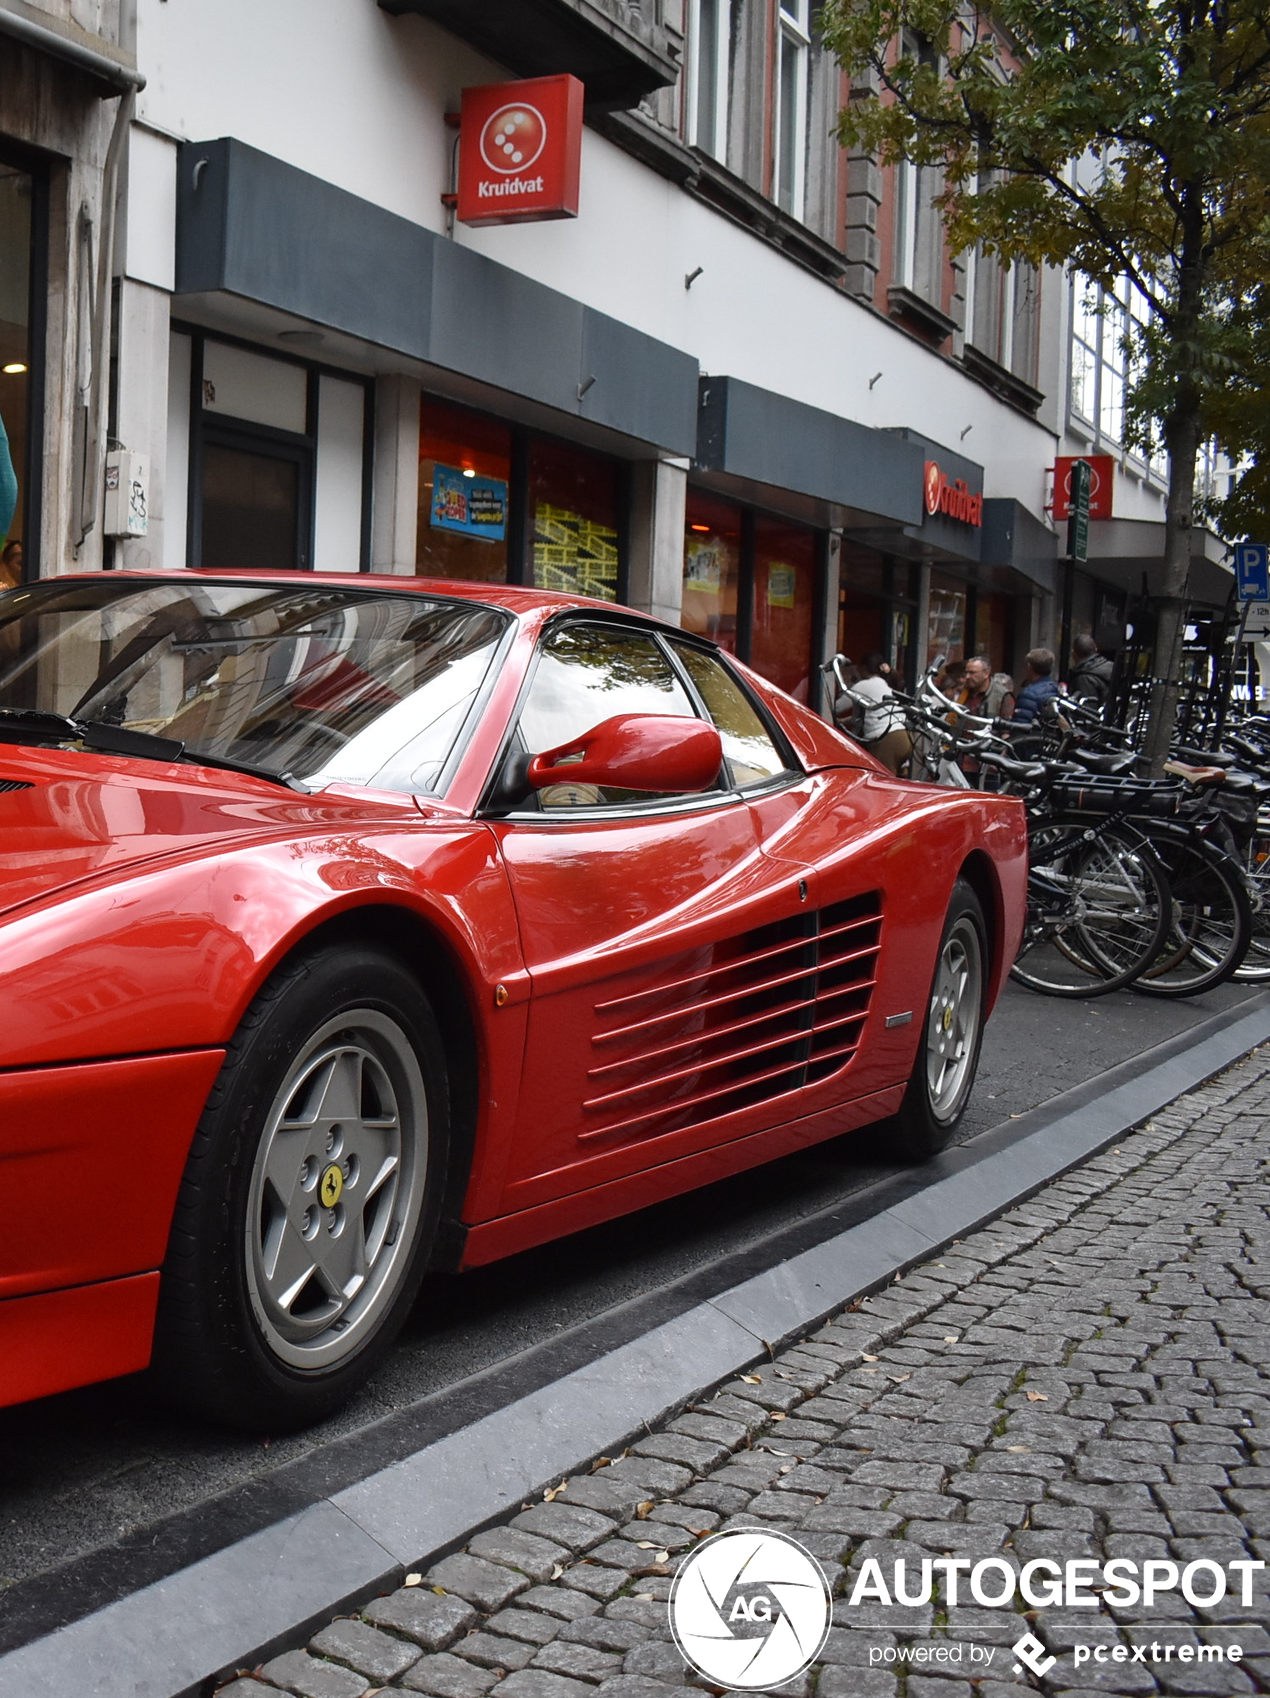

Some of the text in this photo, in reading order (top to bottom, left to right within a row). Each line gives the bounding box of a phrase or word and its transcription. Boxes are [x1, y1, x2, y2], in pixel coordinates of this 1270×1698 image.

[478, 176, 544, 198] Kruidvat
[1243, 549, 1260, 577] P
[1096, 810, 1124, 833] HOTELS
